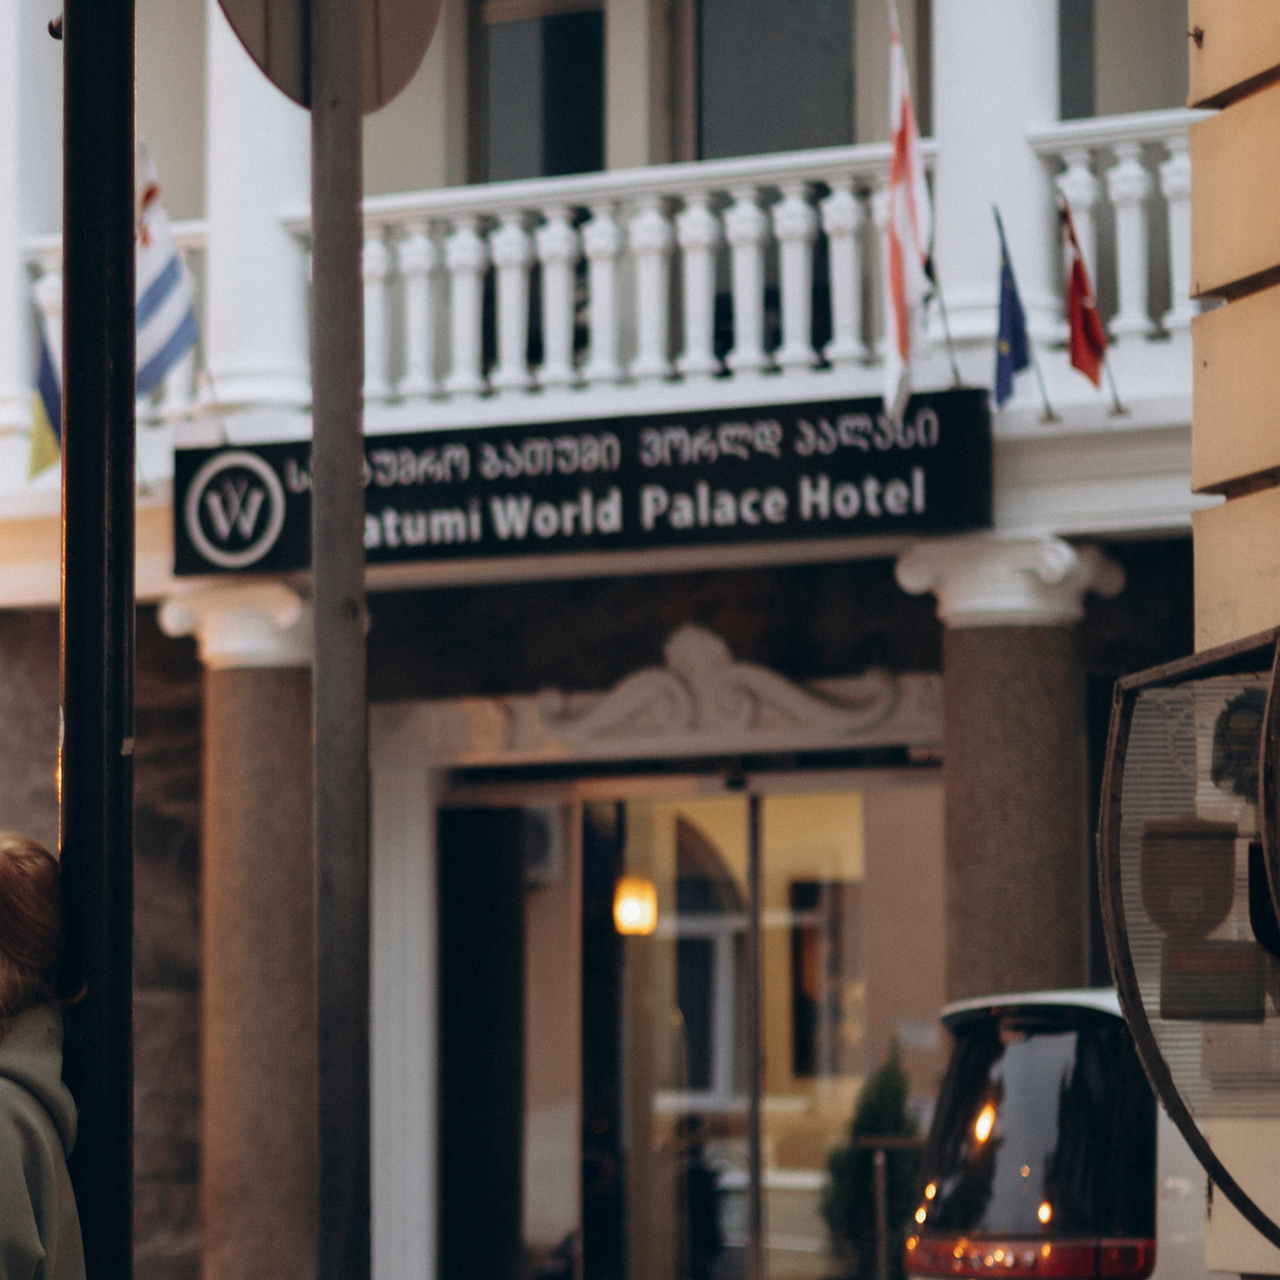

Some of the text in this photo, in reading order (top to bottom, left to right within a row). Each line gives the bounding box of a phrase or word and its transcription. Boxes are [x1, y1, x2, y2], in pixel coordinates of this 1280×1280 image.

[365, 465, 925, 549] atumi World Palace Hotel
